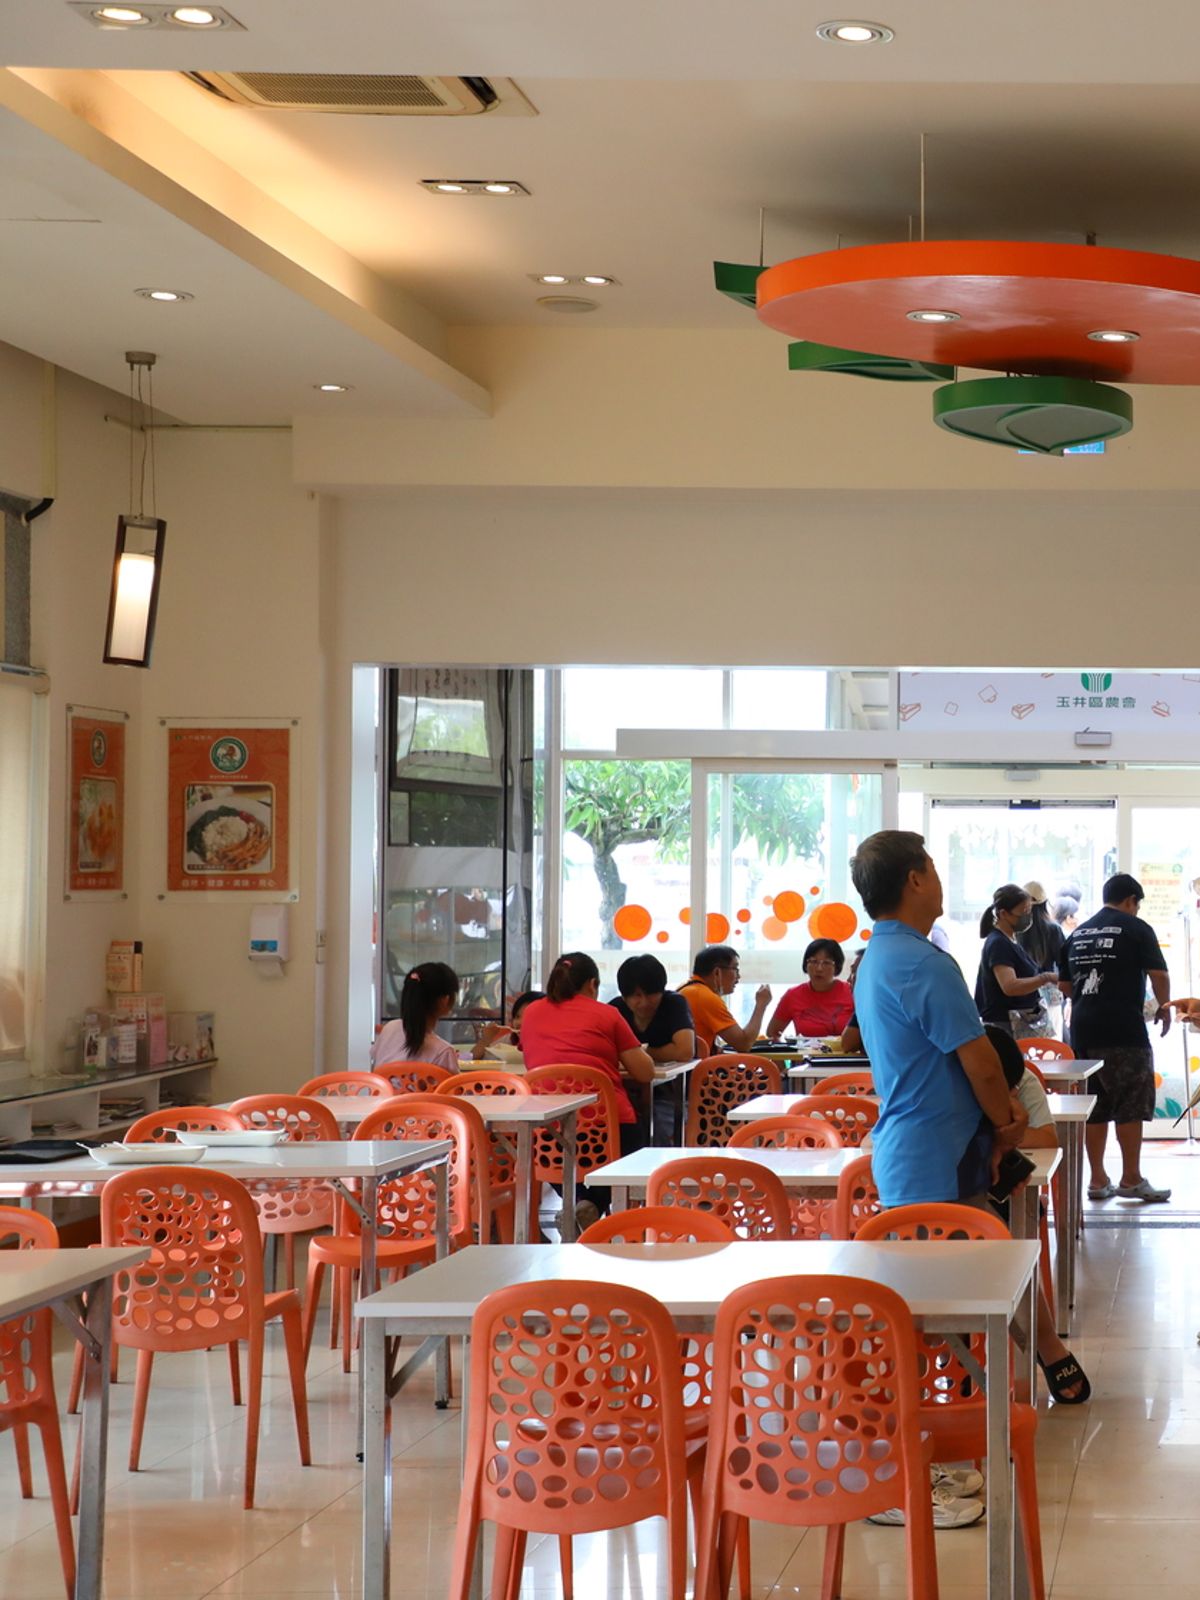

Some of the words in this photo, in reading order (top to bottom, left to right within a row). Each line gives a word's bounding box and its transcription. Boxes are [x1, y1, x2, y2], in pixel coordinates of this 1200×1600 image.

[1056, 695, 1137, 709] 玉井區農會
